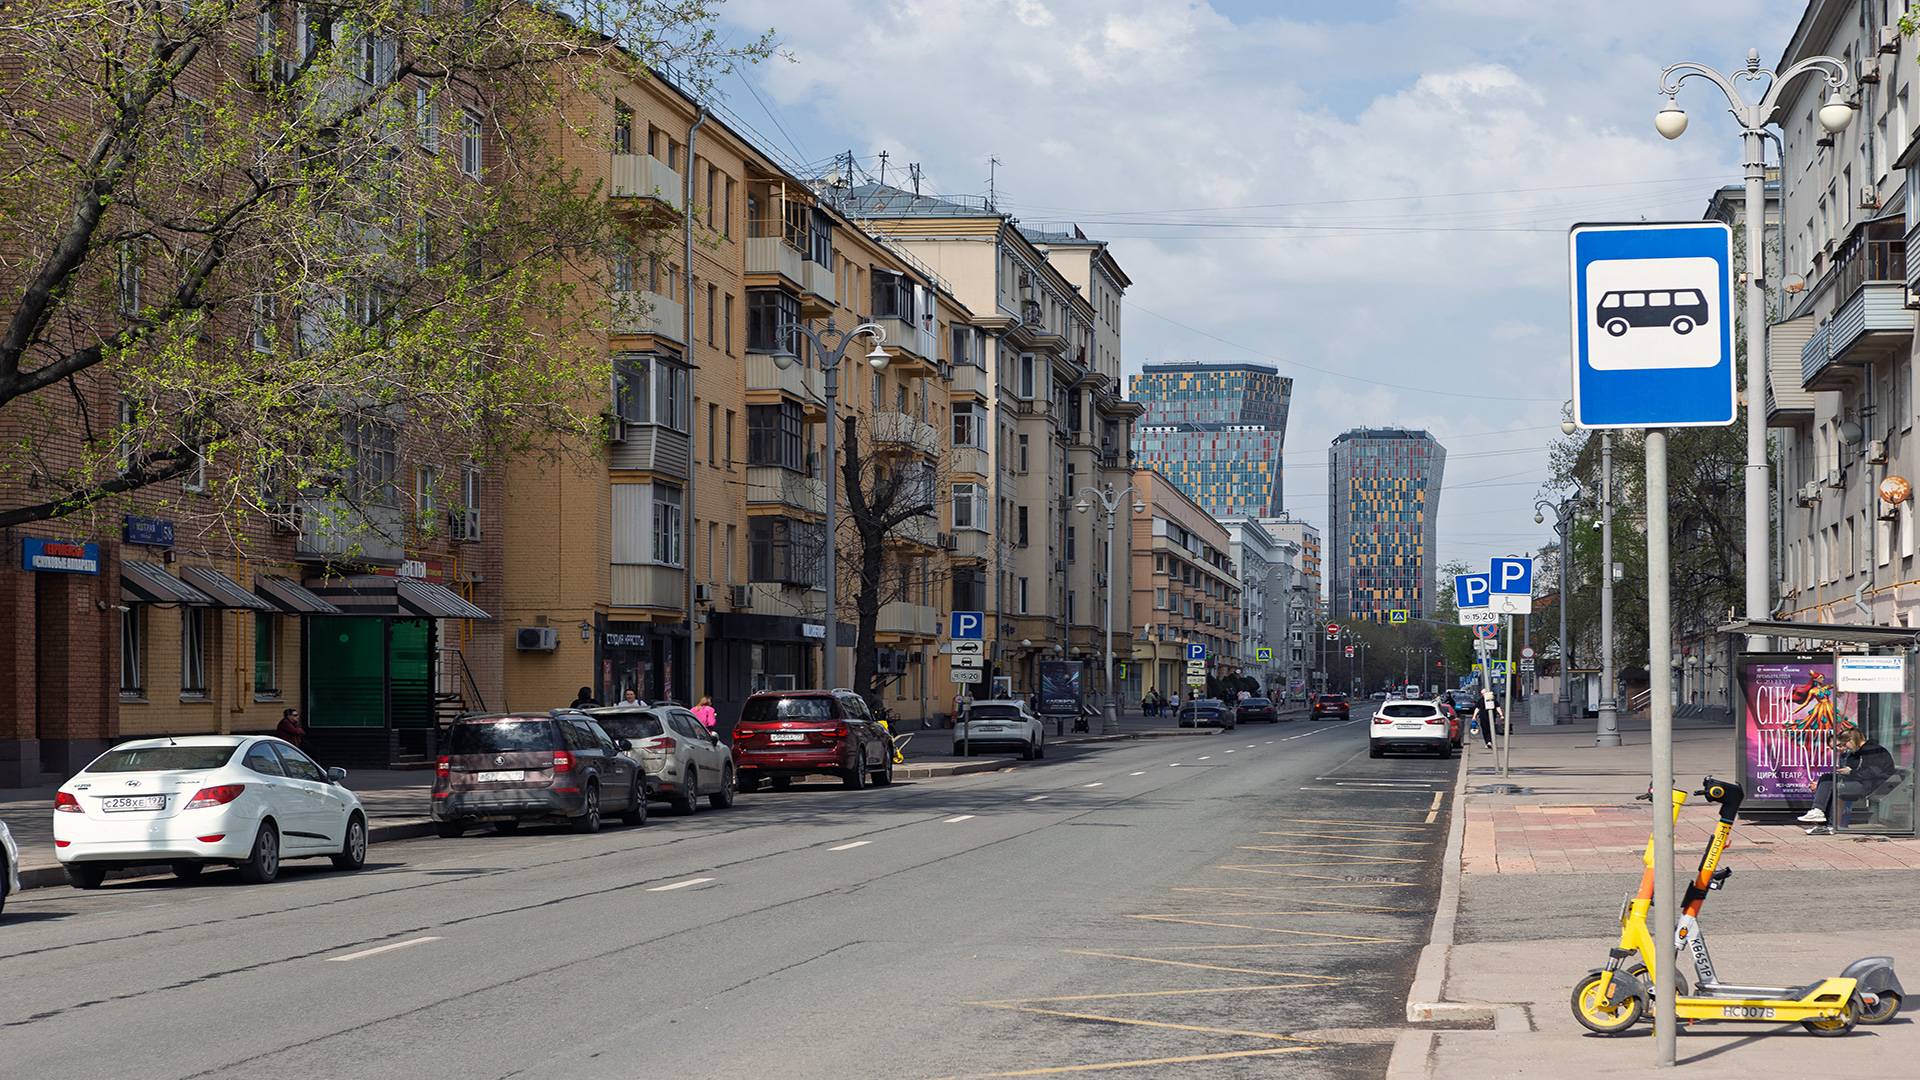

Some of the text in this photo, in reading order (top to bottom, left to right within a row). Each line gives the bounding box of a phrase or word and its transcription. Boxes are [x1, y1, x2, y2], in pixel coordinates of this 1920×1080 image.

[1466, 577, 1488, 604] P
[1501, 562, 1525, 591] P
[960, 614, 978, 637] P
[1482, 611, 1495, 621] 20
[1191, 645, 1203, 659] P
[1756, 684, 1794, 725] СНЫ
[1756, 728, 1840, 782] ПУШКИН
[1704, 825, 1729, 870] WHOOSH
